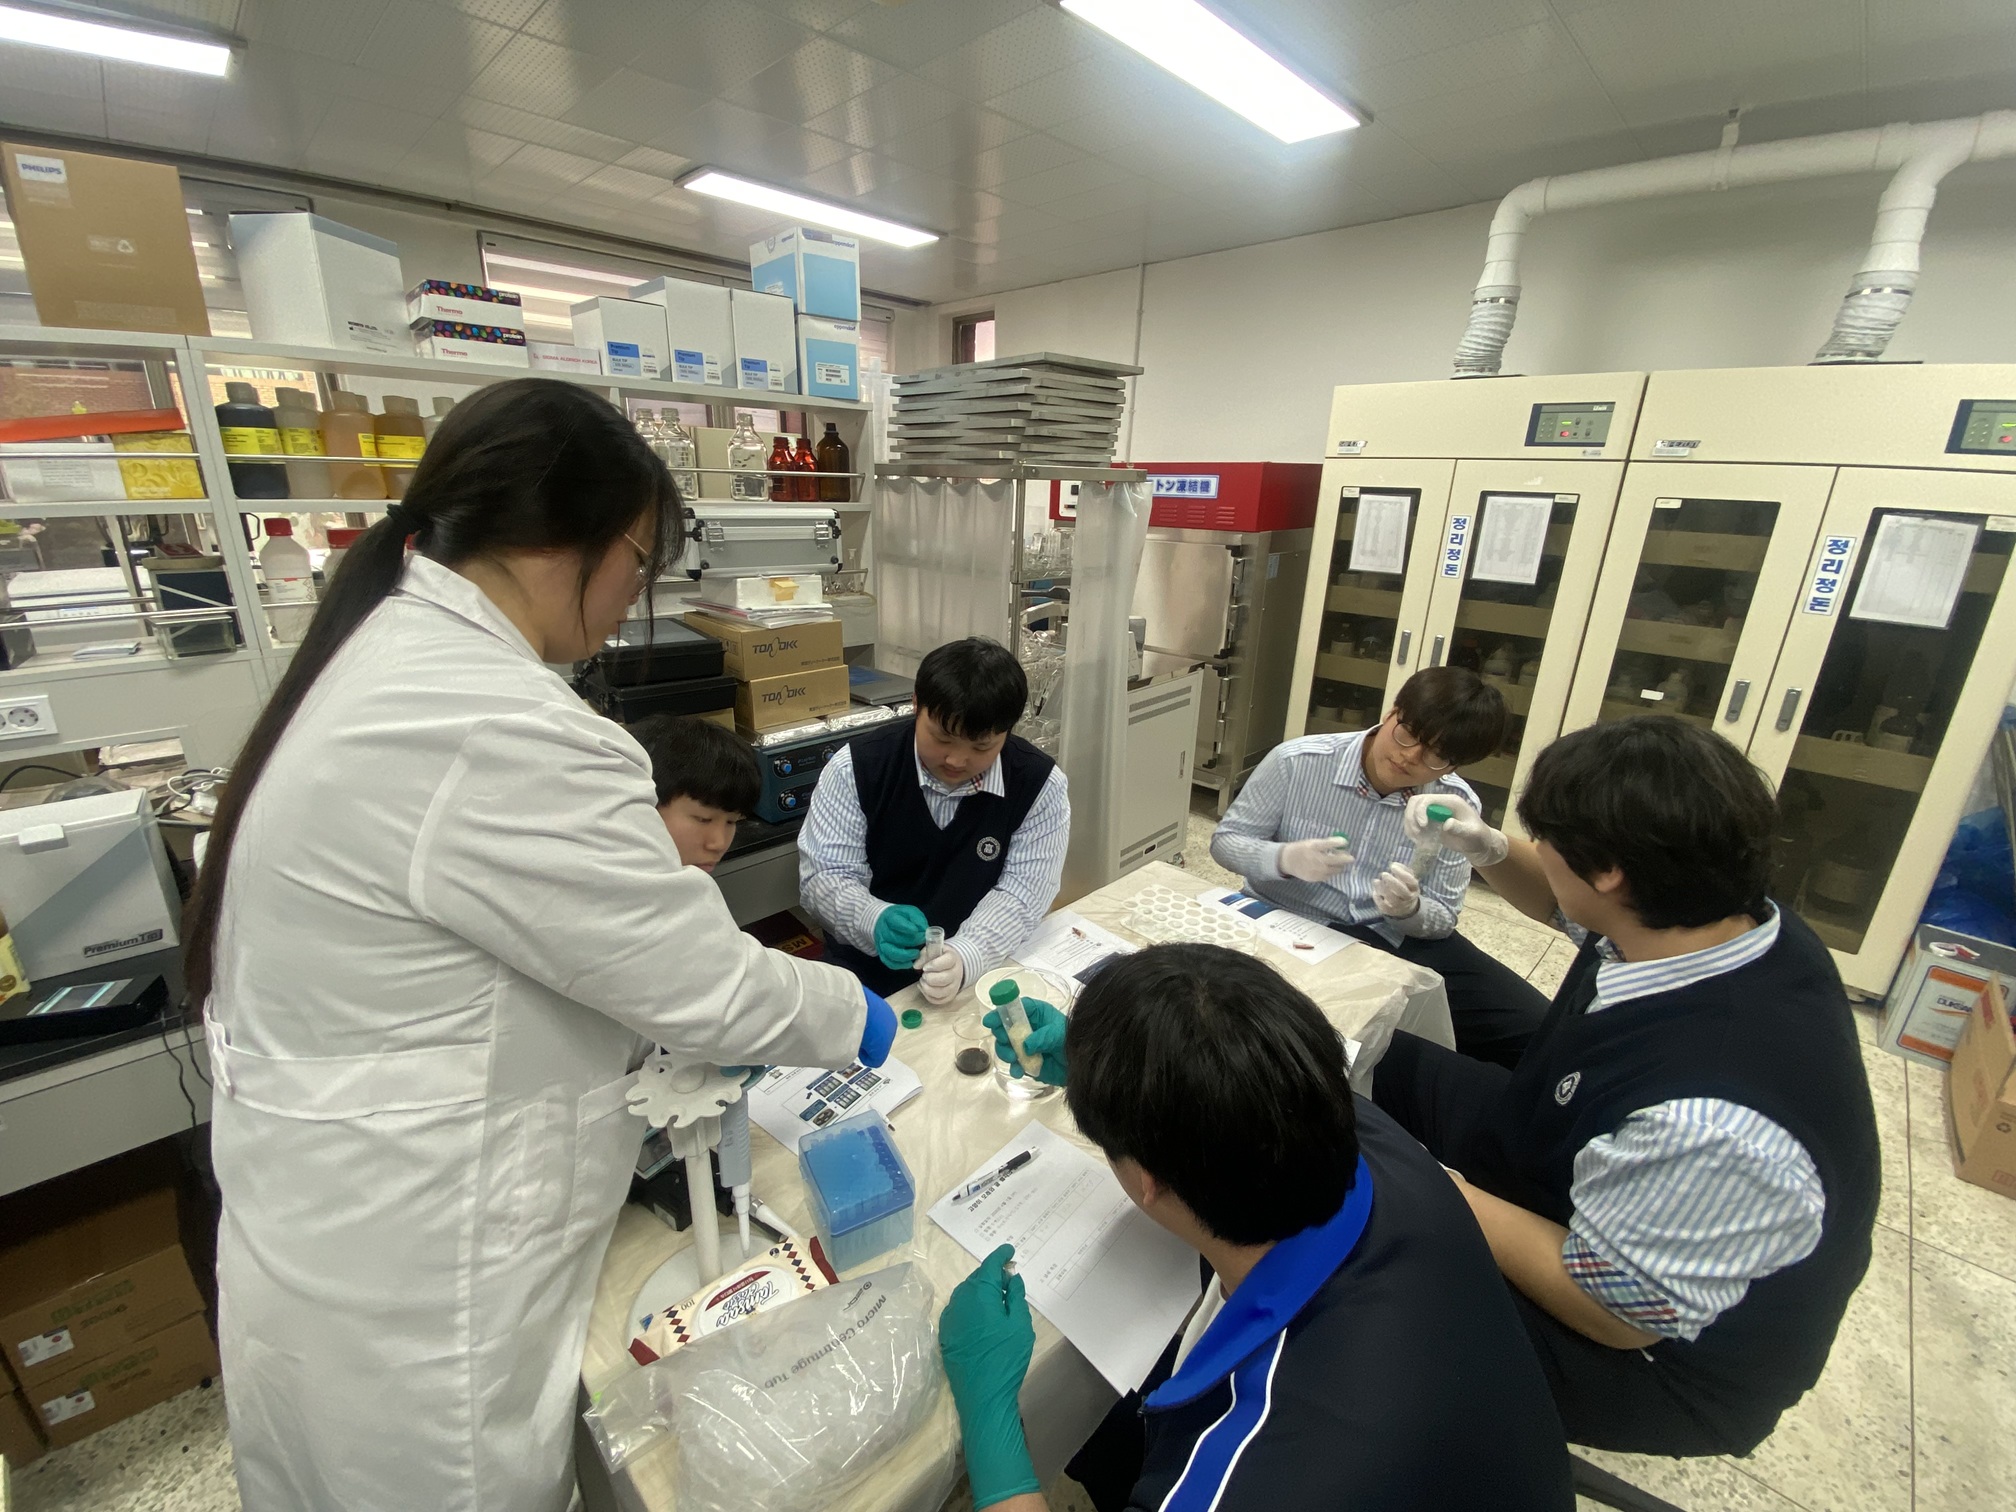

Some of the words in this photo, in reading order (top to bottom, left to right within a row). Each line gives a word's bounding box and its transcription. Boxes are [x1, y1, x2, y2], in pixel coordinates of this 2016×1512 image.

[21, 163, 62, 175] PHILIPS
[436, 305, 463, 315] Thermo
[833, 324, 856, 332] eppendorf
[502, 333, 523, 341] protein
[441, 348, 468, 357] Thermo
[1444, 517, 1467, 576] 정리정돈
[1809, 539, 1850, 612] 정리정돈
[680, 1299, 695, 1311] 100
[716, 1280, 779, 1327] Tamsaa
